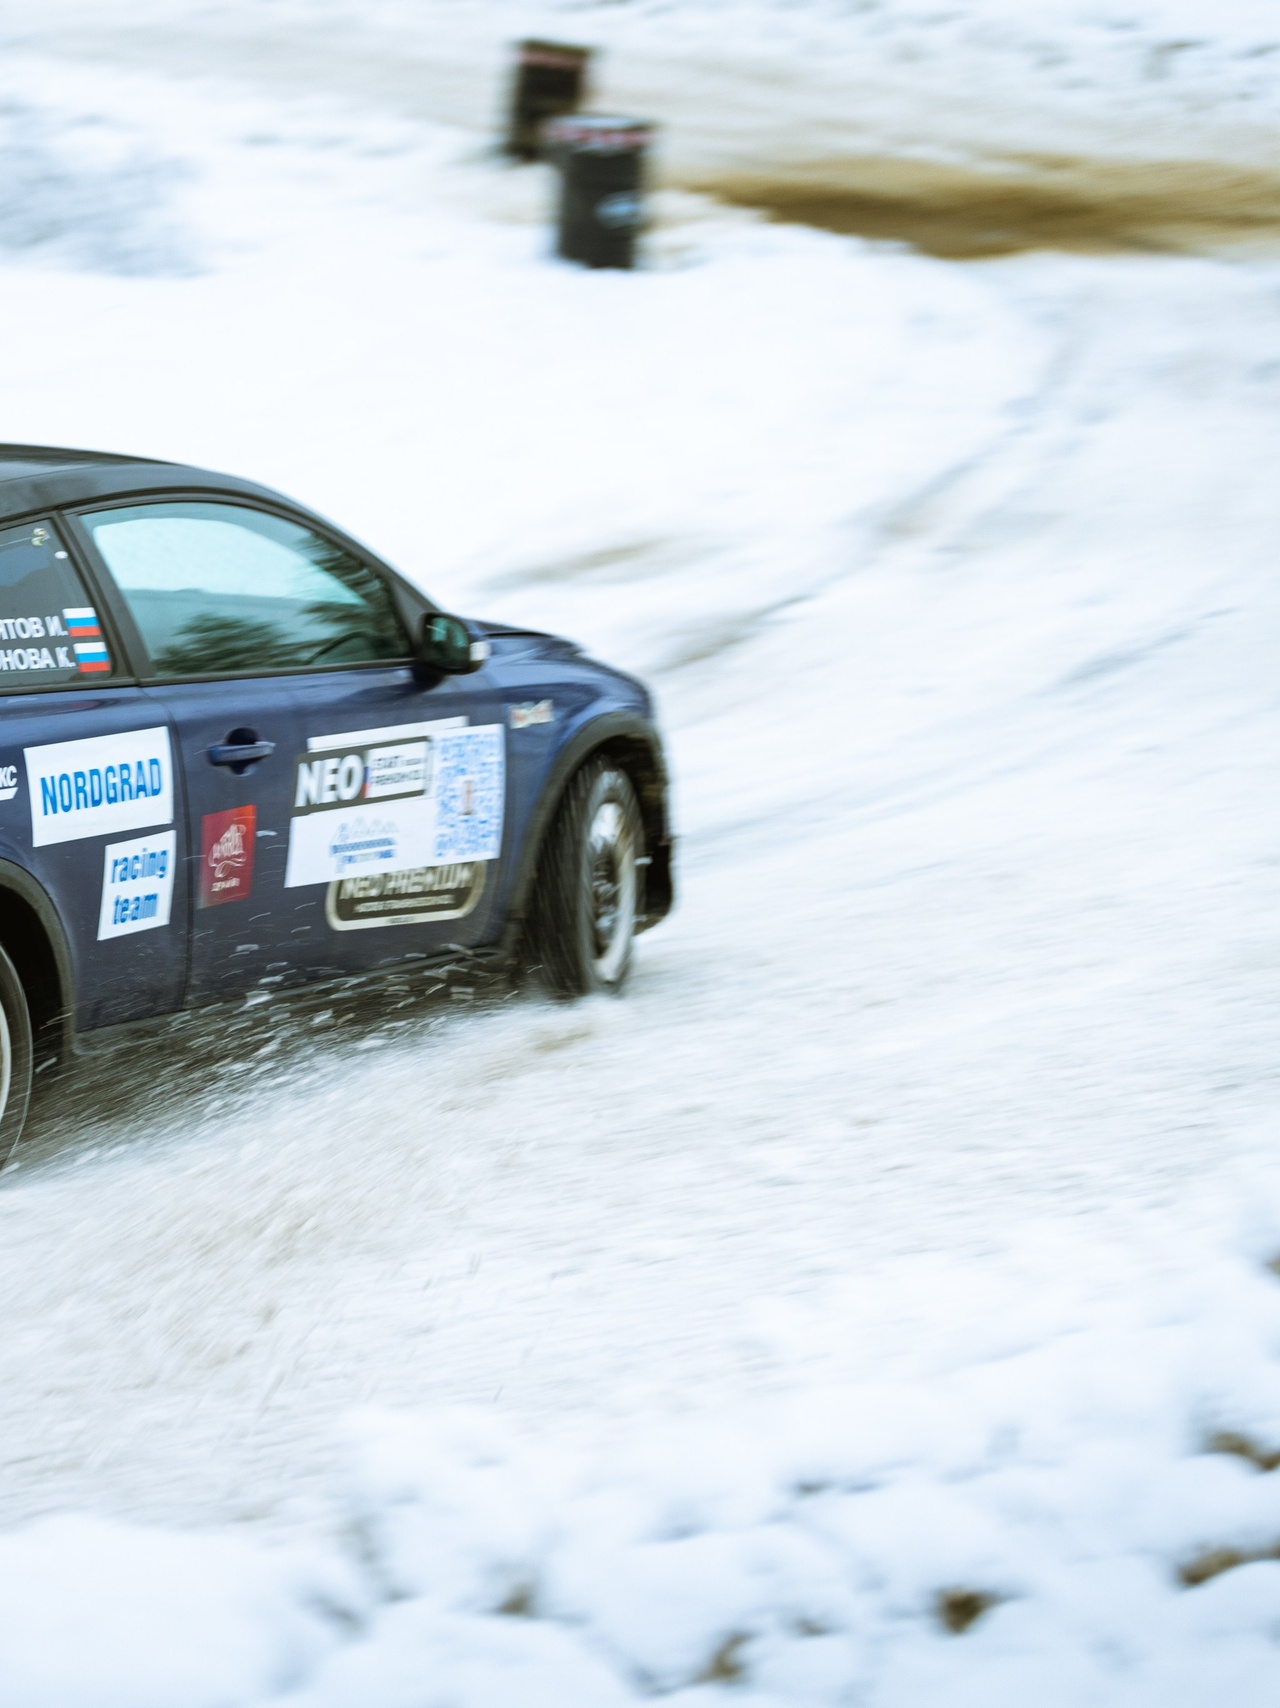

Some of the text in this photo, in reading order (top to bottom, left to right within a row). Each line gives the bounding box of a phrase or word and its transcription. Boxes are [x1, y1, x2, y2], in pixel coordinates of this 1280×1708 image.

[40, 757, 162, 816] NORDGRAD
[295, 754, 364, 808] NEO
[111, 847, 168, 884] racing
[113, 893, 158, 925] team
